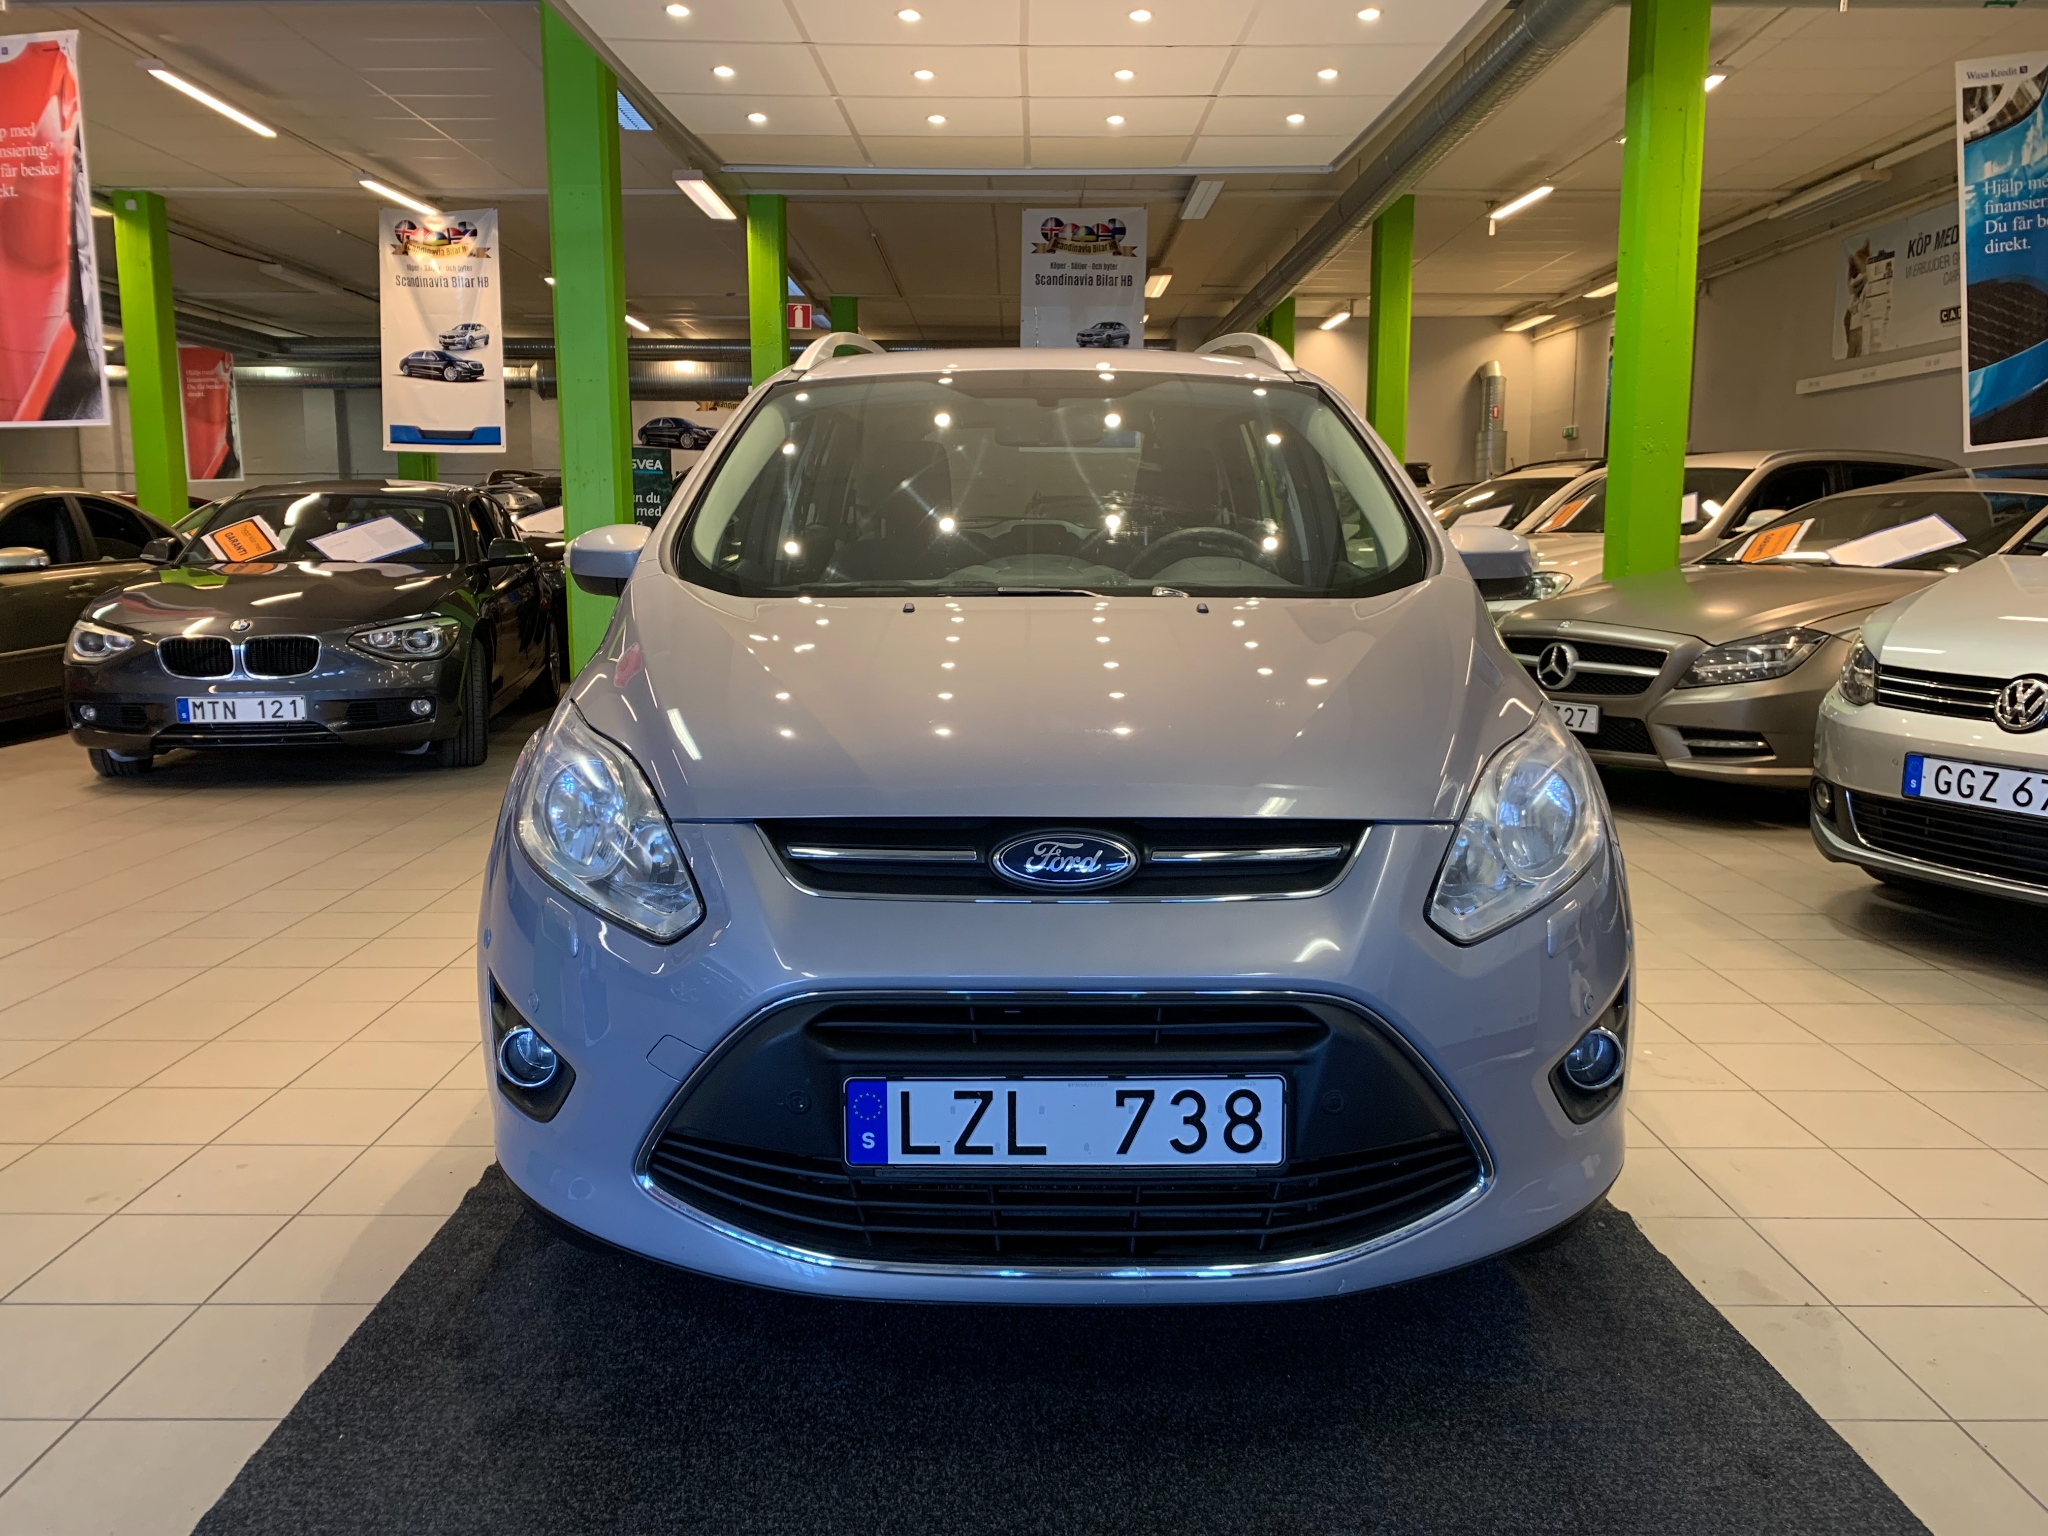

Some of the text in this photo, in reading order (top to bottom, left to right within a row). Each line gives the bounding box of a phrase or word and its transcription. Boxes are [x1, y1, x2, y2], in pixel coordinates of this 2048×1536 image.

[1966, 67, 2017, 80] Wasa Kredit
[10, 121, 36, 138] med
[1, 160, 60, 178] får besked
[1984, 179, 2023, 198] Hjälp
[1985, 219, 2008, 235] Du
[2012, 215, 2033, 231] får
[1907, 224, 1960, 259] KÖP MED
[1985, 236, 2031, 254] direkt.
[395, 274, 489, 288] Scandinavia Bilar HB
[1035, 273, 1133, 287] Scandinavia Bilar HB
[646, 491, 660, 503] du
[636, 505, 662, 517] med
[225, 532, 248, 557] GARANTI
[192, 701, 236, 720] MTN
[257, 699, 298, 719] 121
[1910, 779, 1917, 788] S
[1934, 765, 2000, 803] GGZ
[1024, 841, 1104, 873] Ford
[861, 1089, 1263, 1155] S LZL 738
